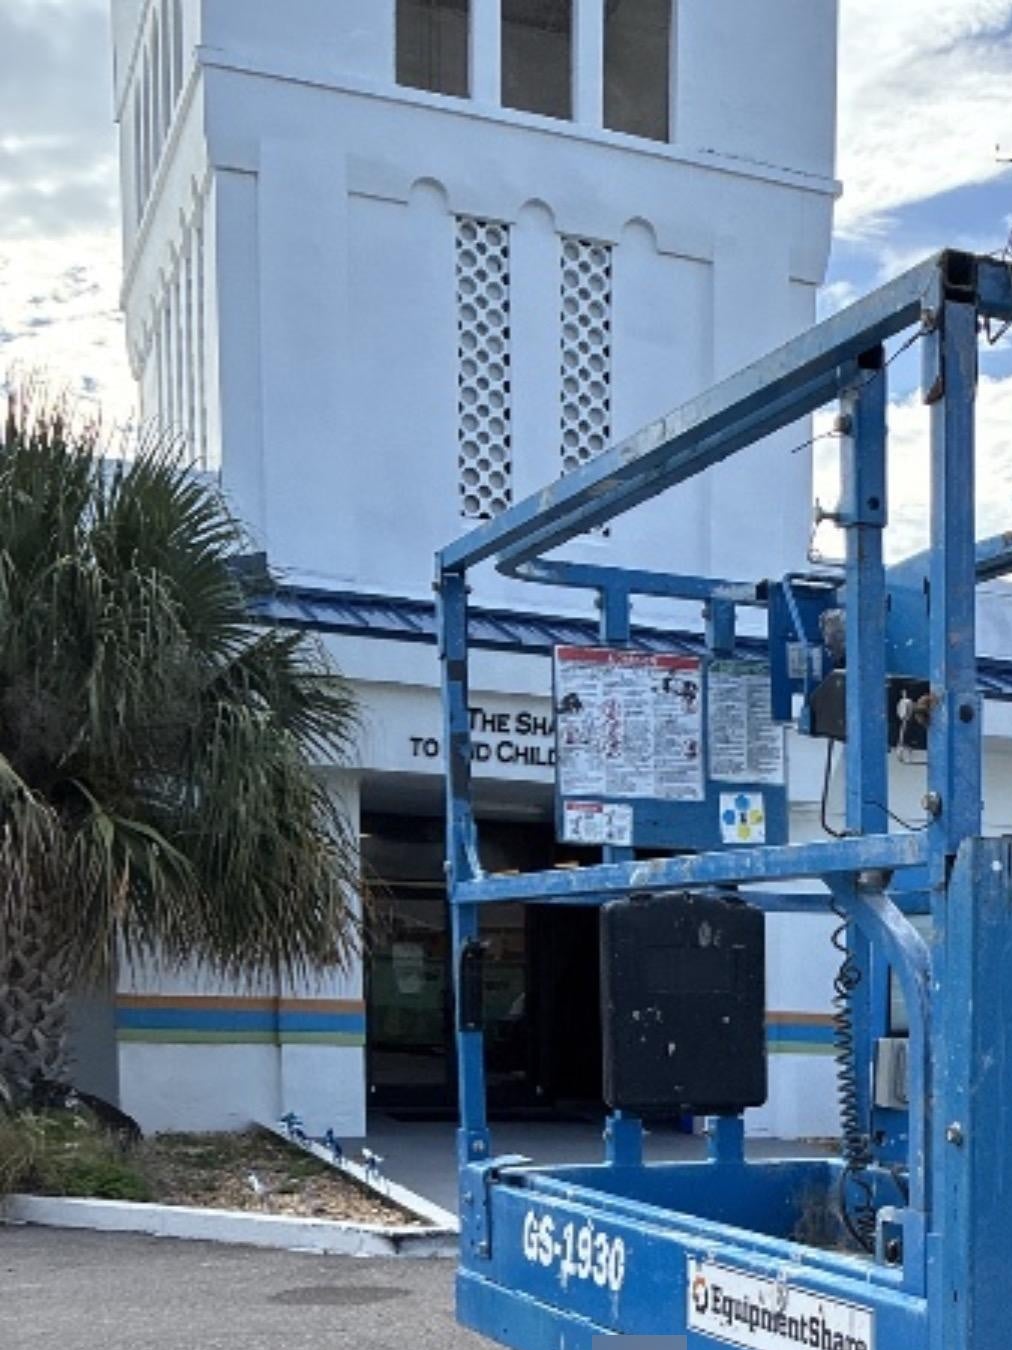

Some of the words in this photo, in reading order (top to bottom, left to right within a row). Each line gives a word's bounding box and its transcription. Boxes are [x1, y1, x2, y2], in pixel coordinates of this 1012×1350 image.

[467, 707, 510, 733] THE
[409, 737, 440, 757] TO
[523, 1208, 625, 1292] GS-1930
